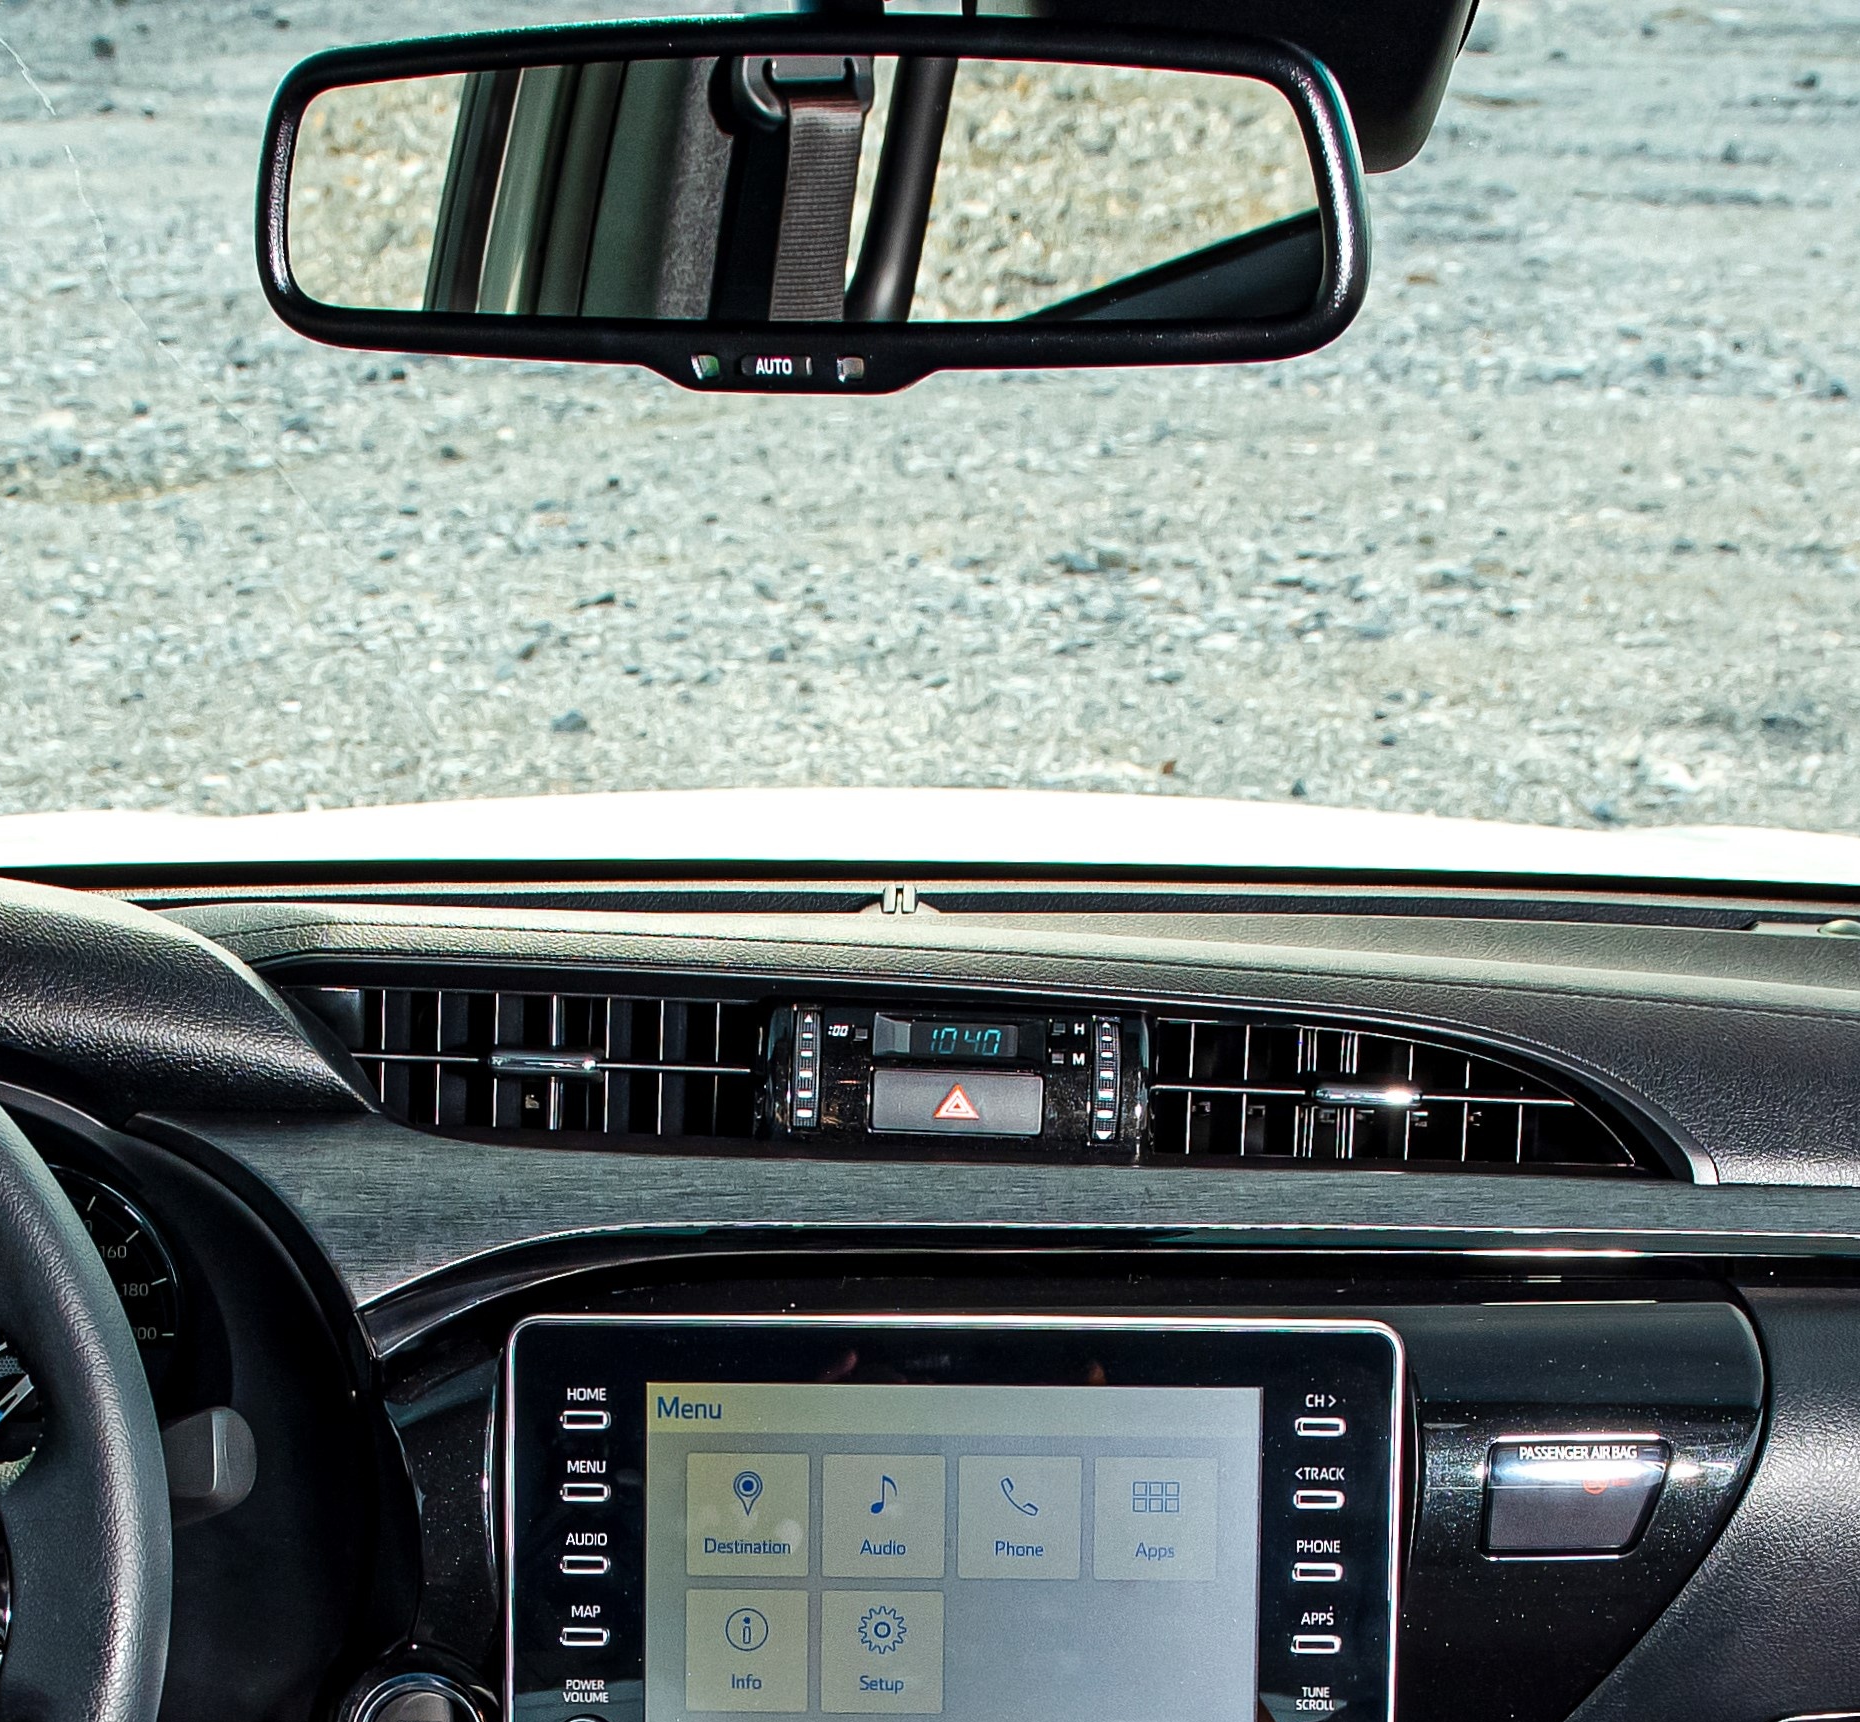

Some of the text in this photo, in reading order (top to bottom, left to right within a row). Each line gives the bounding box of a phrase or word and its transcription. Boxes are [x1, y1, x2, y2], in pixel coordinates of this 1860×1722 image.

[755, 358, 793, 375] AUTO
[1074, 1023, 1085, 1035] H
[1072, 1053, 1086, 1066] M
[121, 1283, 149, 1297] 180
[566, 1387, 607, 1401] HOME
[656, 1395, 723, 1420] Menu
[1518, 1445, 1590, 1461] PASSENGER
[566, 1460, 607, 1474] MENU
[565, 1532, 608, 1546] AUDIO
[703, 1537, 791, 1555] Destination
[859, 1539, 907, 1556] Audio
[994, 1540, 1044, 1557] Phone
[1135, 1542, 1175, 1561] Apps
[1296, 1539, 1341, 1554] PHONE
[571, 1604, 601, 1618] MAP
[1300, 1612, 1335, 1626] APPS
[565, 1679, 605, 1691] POWER
[731, 1673, 762, 1690] Info
[859, 1675, 904, 1694] Setup
[562, 1692, 609, 1703] VOLUME
[1301, 1686, 1330, 1698] TUNE
[1295, 1699, 1335, 1711] SCROLL
